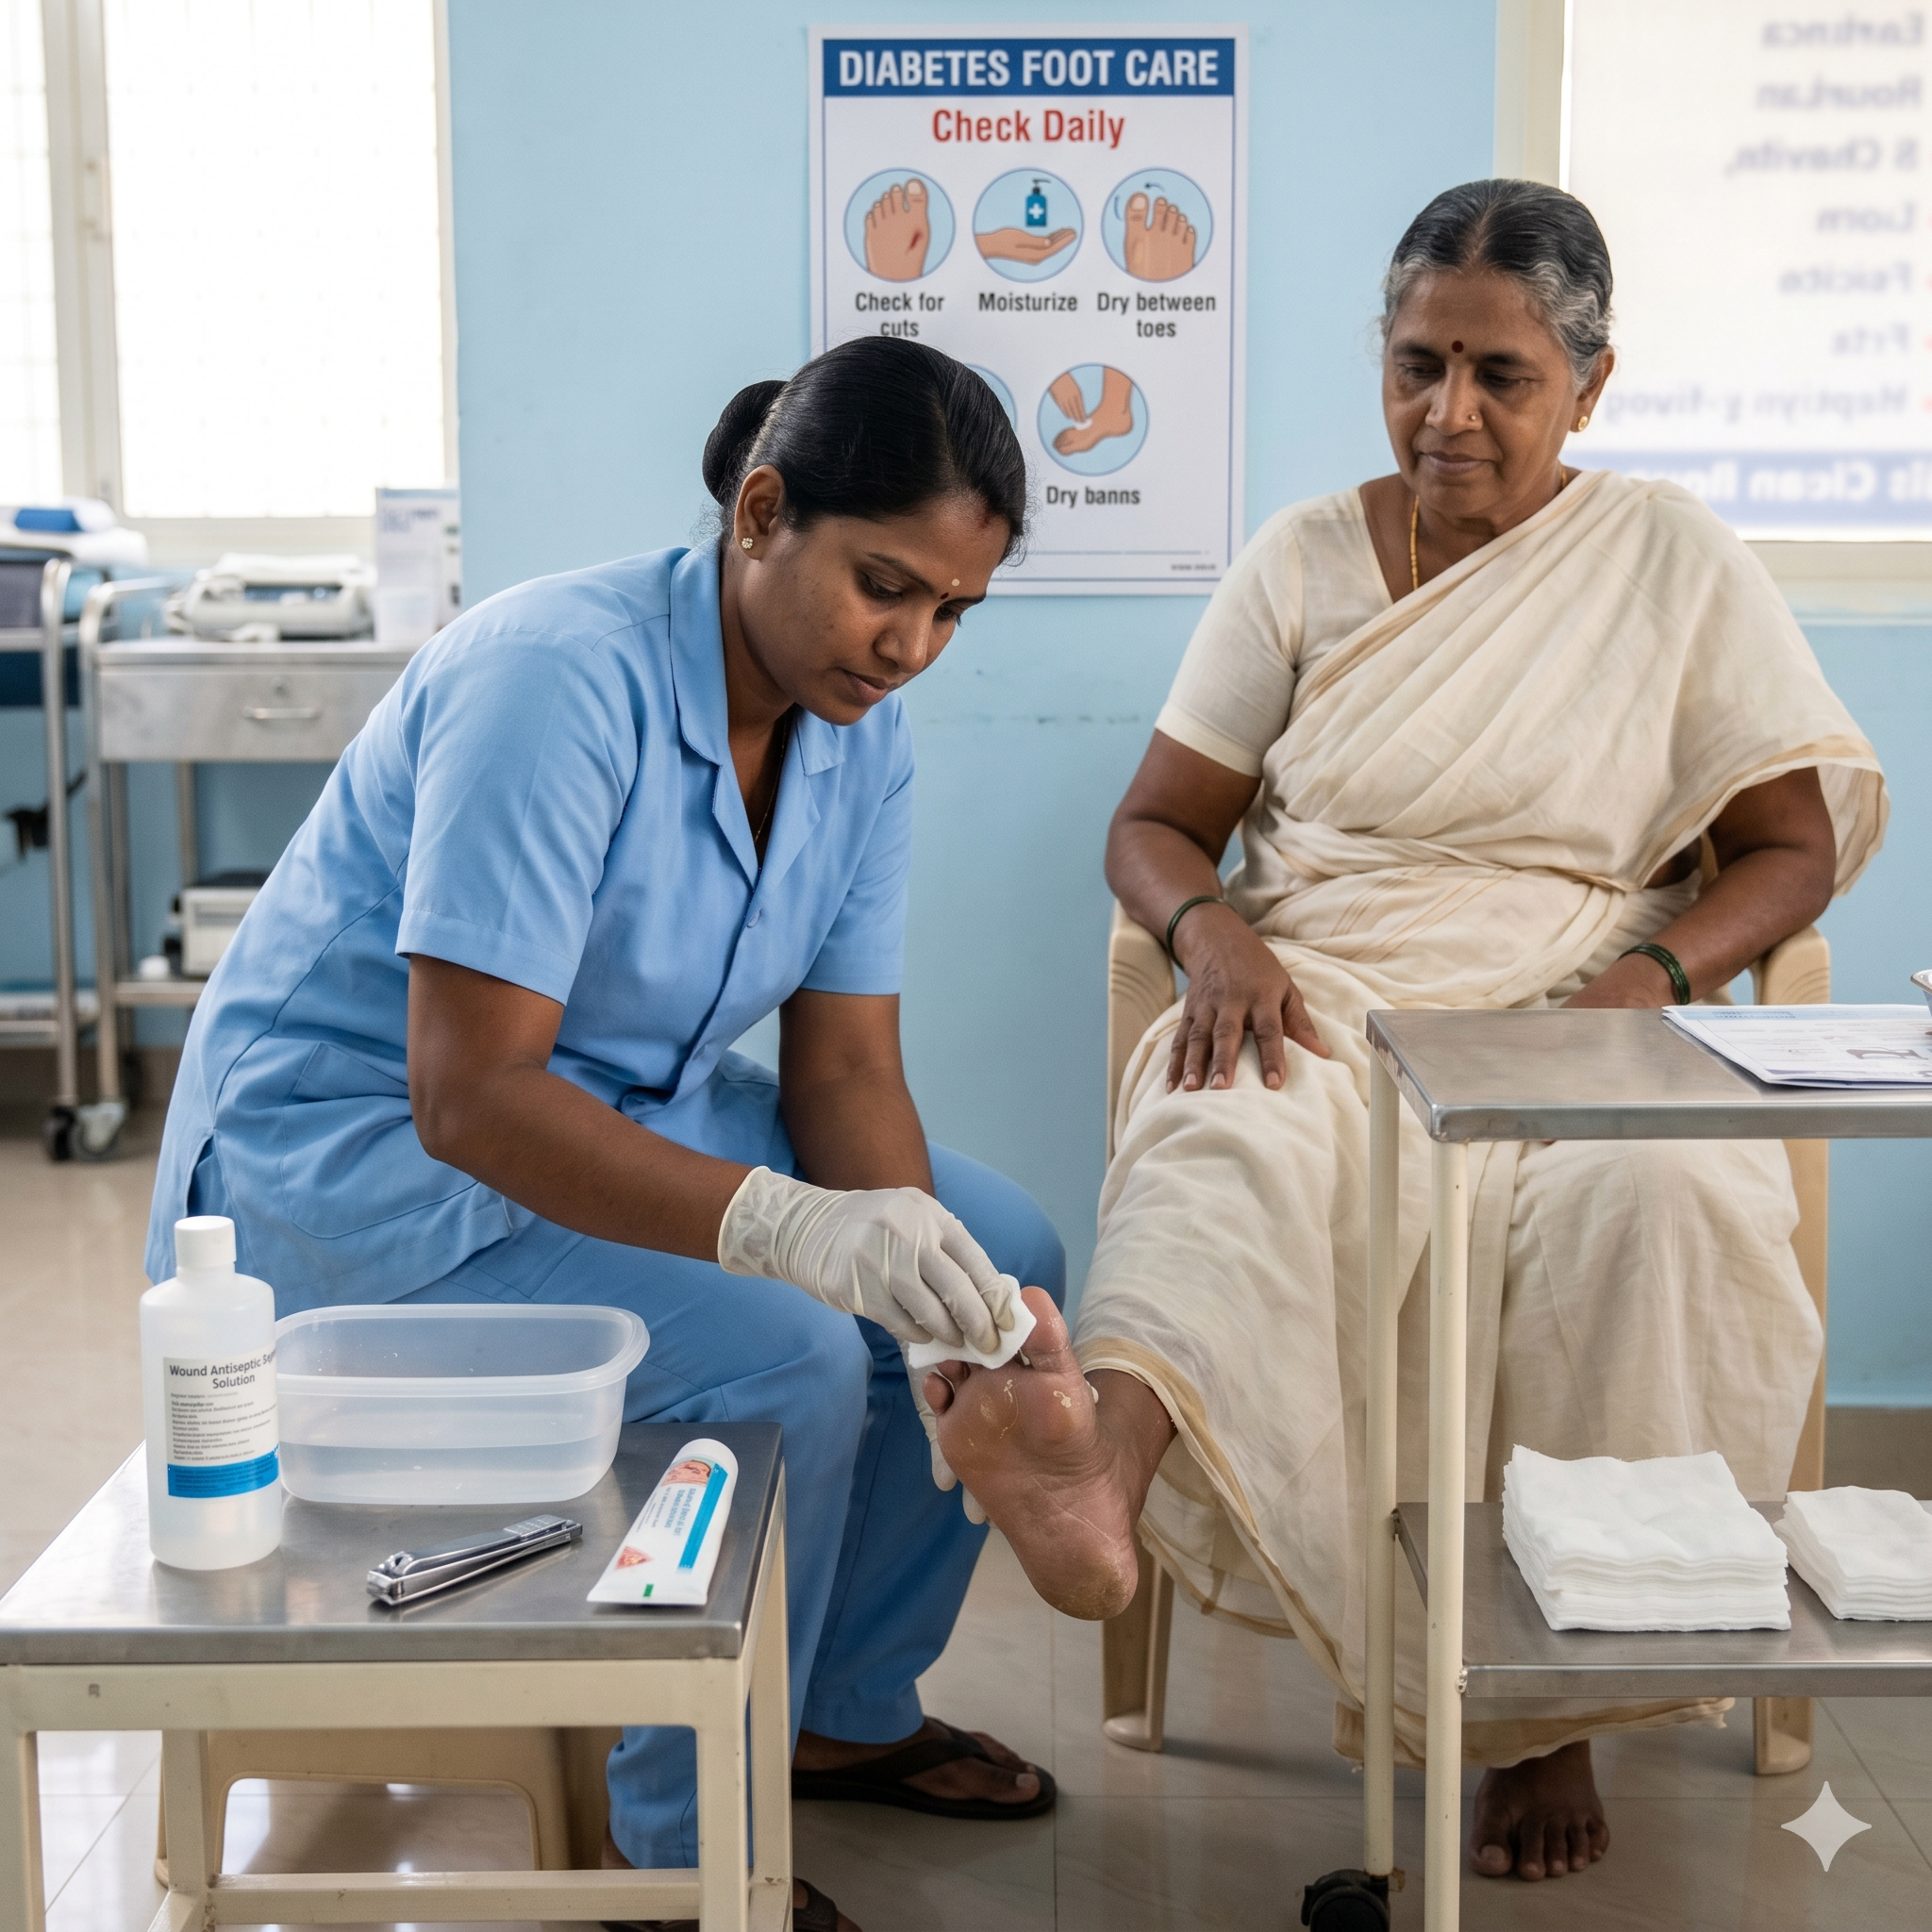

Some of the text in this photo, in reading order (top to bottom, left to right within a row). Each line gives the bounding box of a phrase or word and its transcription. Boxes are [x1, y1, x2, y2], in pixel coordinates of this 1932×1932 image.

[839, 49, 1219, 87] DIABETES FOOT CARE
[932, 109, 1124, 149] Check Daily
[855, 291, 945, 311] Check for
[978, 291, 1078, 311] Moisturize
[1097, 292, 1216, 315] Dry between
[880, 319, 919, 337] cuts
[1136, 319, 1176, 338] toes
[1046, 486, 1141, 508] Dry banns
[169, 1357, 261, 1376] Wound Antiseptic
[212, 1374, 256, 1390] Solution
